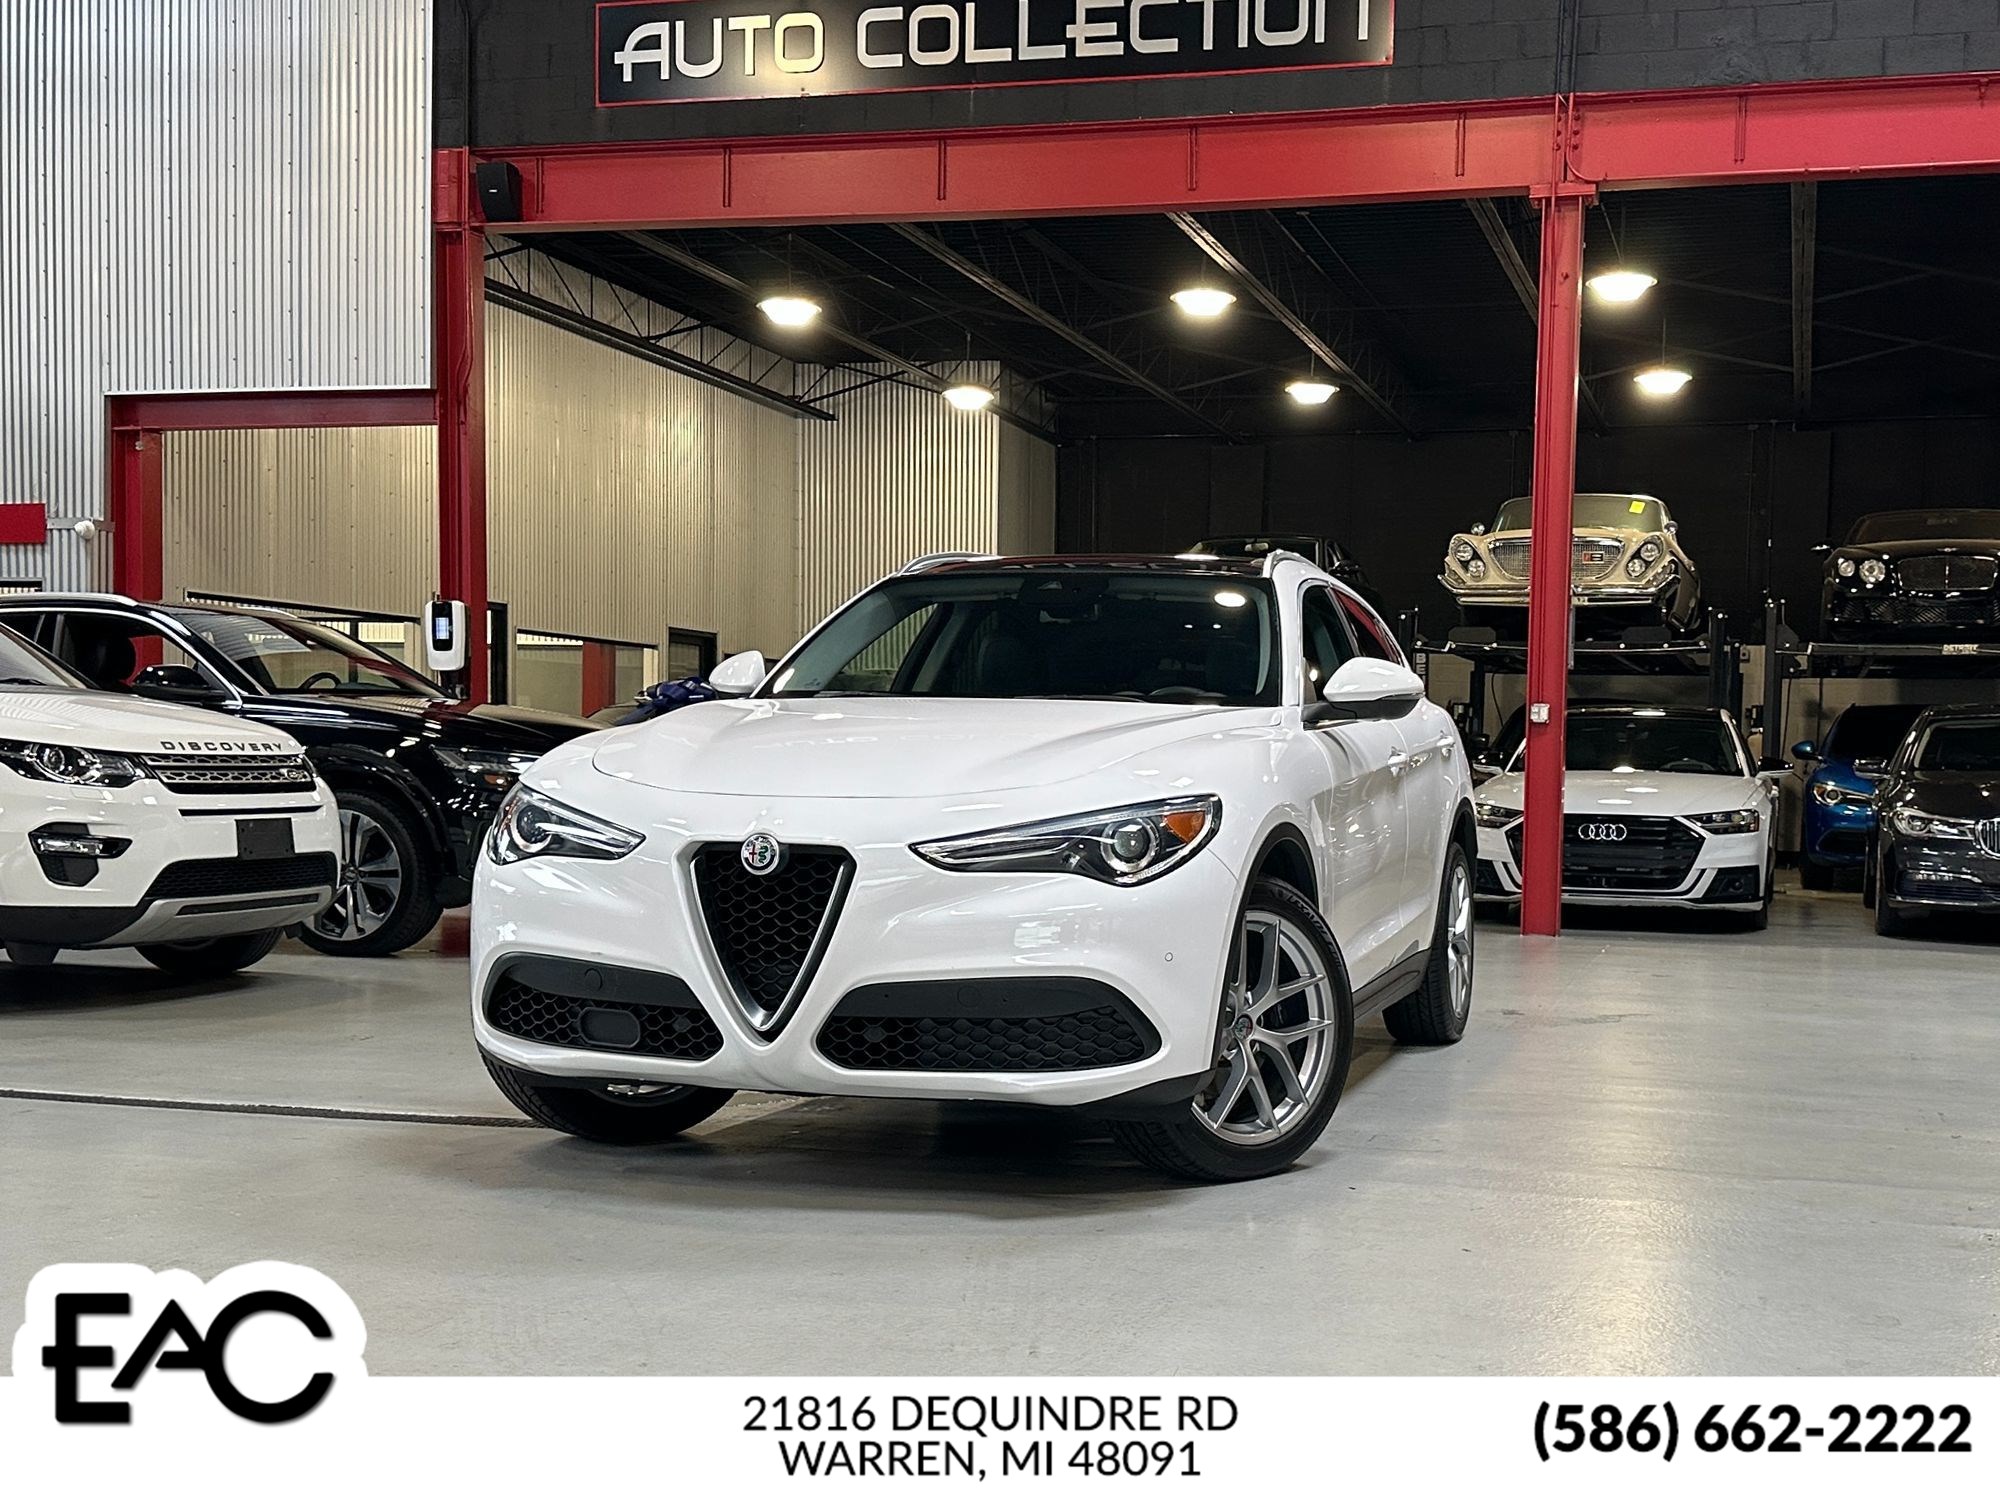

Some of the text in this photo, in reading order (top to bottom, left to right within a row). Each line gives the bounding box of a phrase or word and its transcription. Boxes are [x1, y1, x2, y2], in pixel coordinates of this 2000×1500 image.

[614, 0, 1369, 82] AUTO COLLECTION
[160, 741, 283, 752] DISCOVERY
